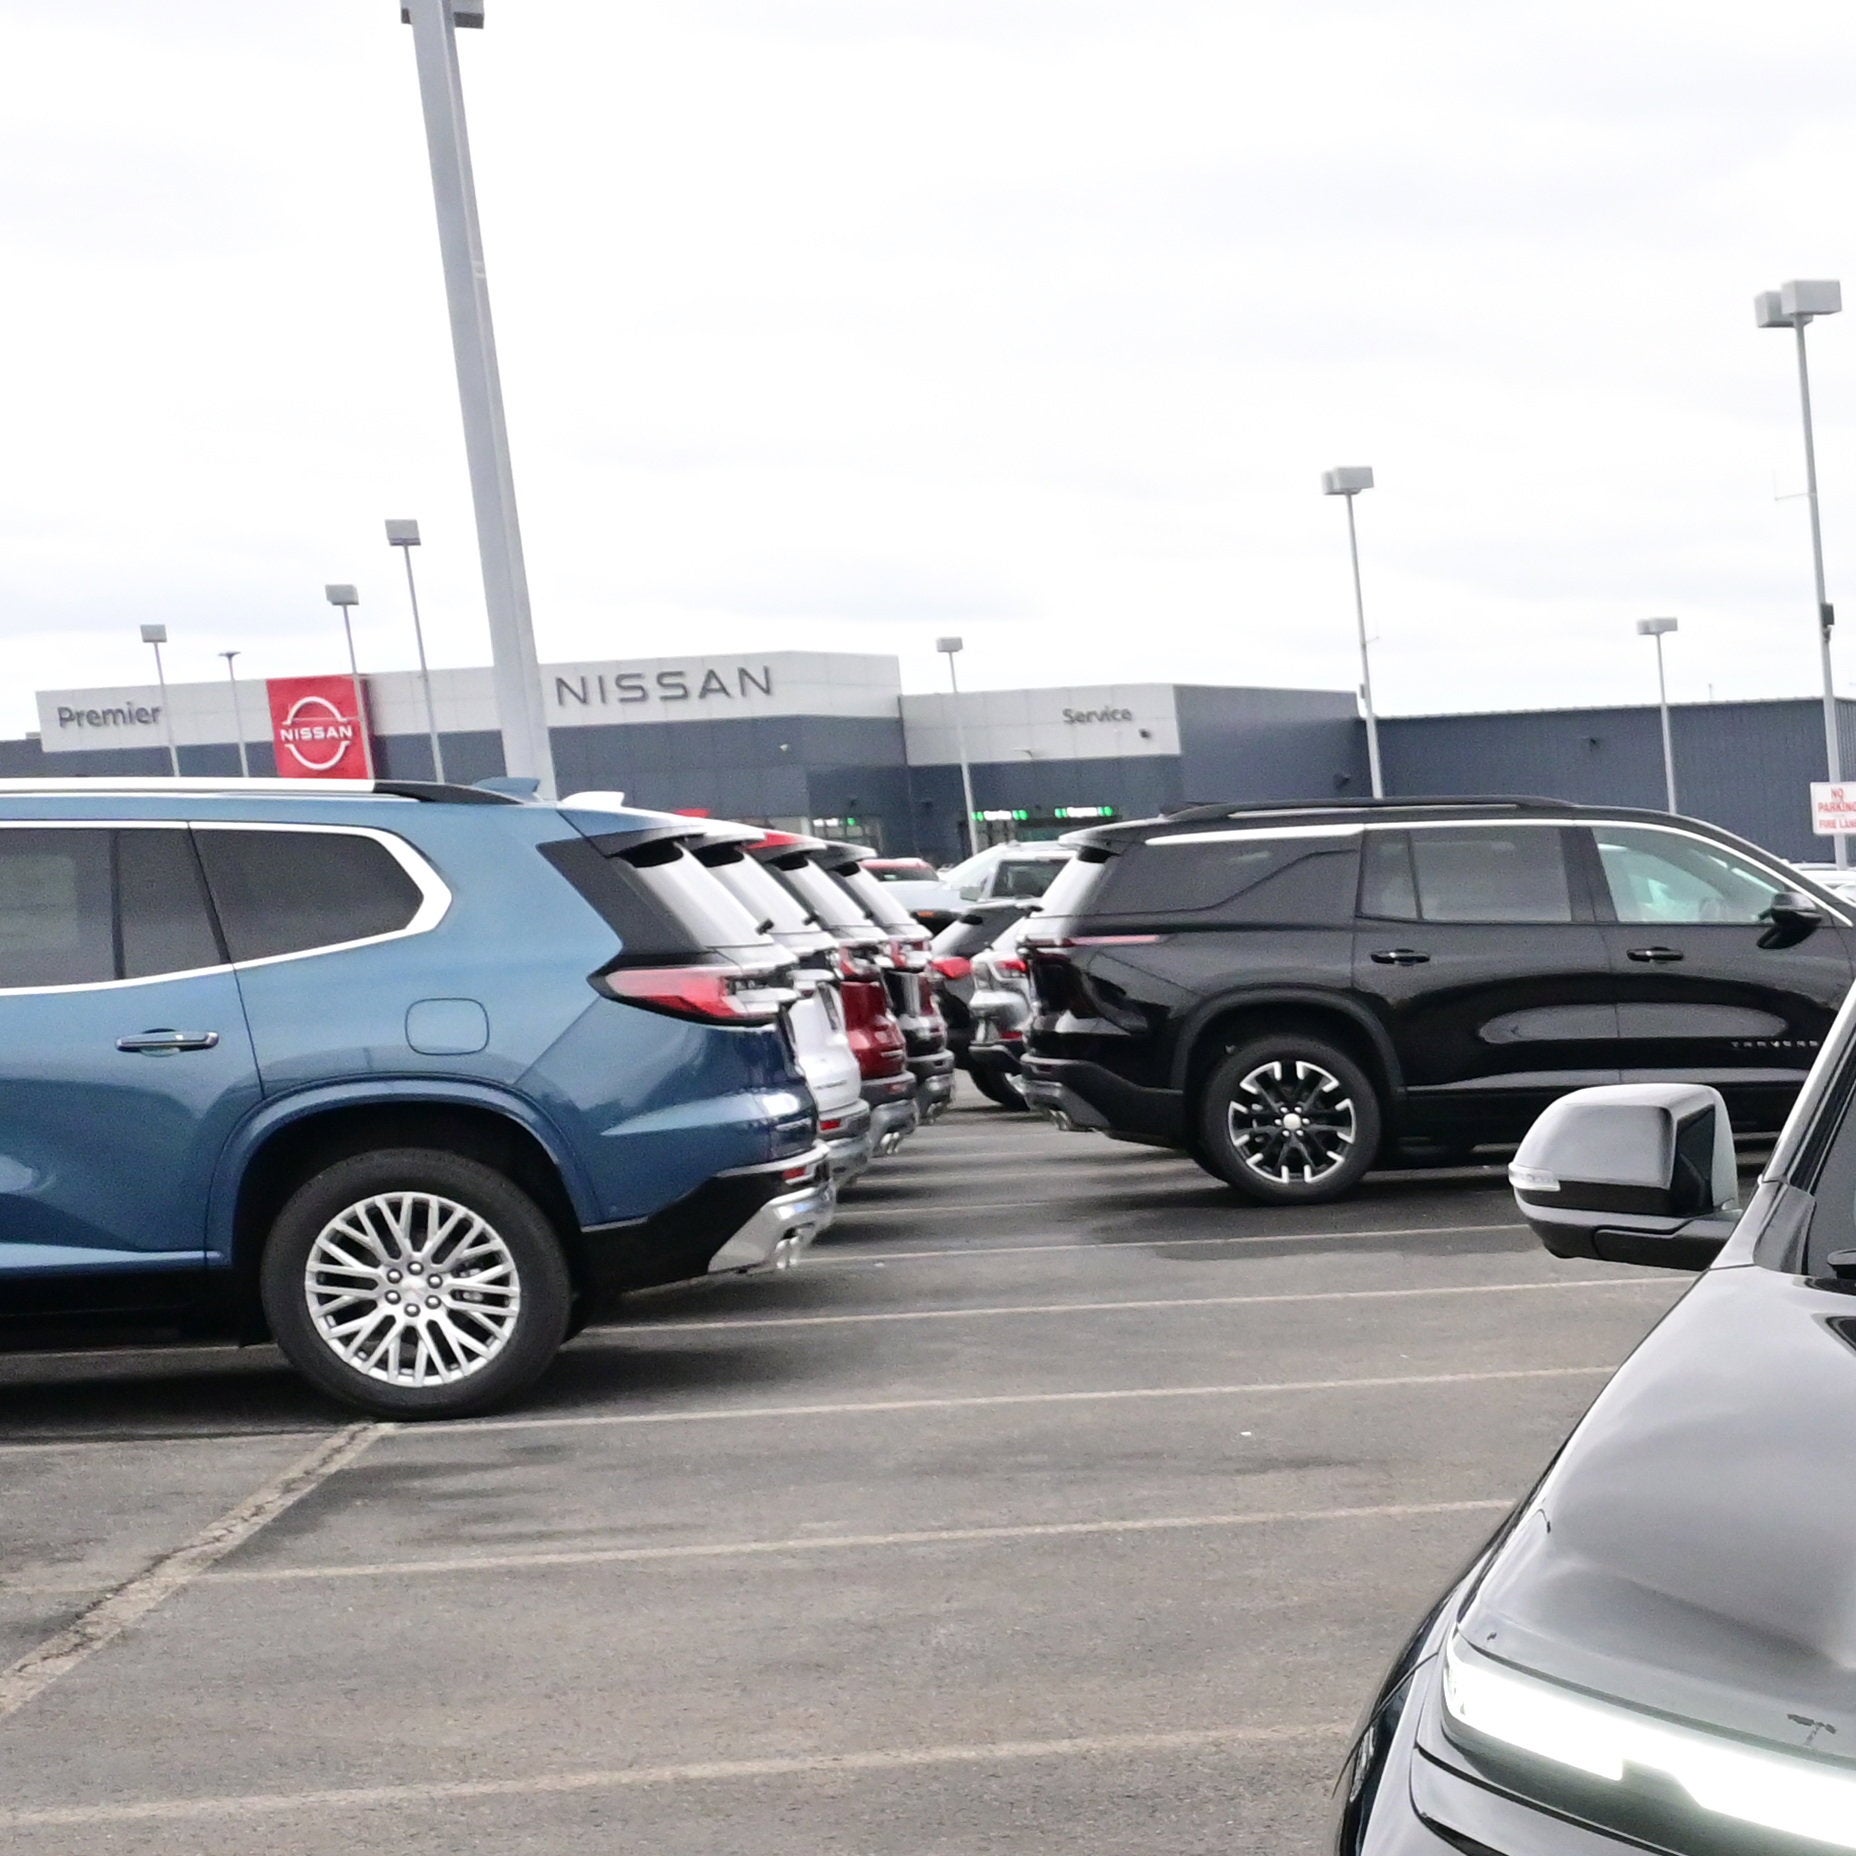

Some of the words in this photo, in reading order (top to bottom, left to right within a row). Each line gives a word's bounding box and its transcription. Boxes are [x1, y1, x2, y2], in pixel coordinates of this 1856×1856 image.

[555, 665, 773, 706] NISSAN
[57, 701, 161, 728] Premier
[1061, 706, 1133, 725] Service
[280, 726, 353, 741] NISSAN
[1830, 787, 1844, 799] NO
[1819, 819, 1837, 829] FIRE
